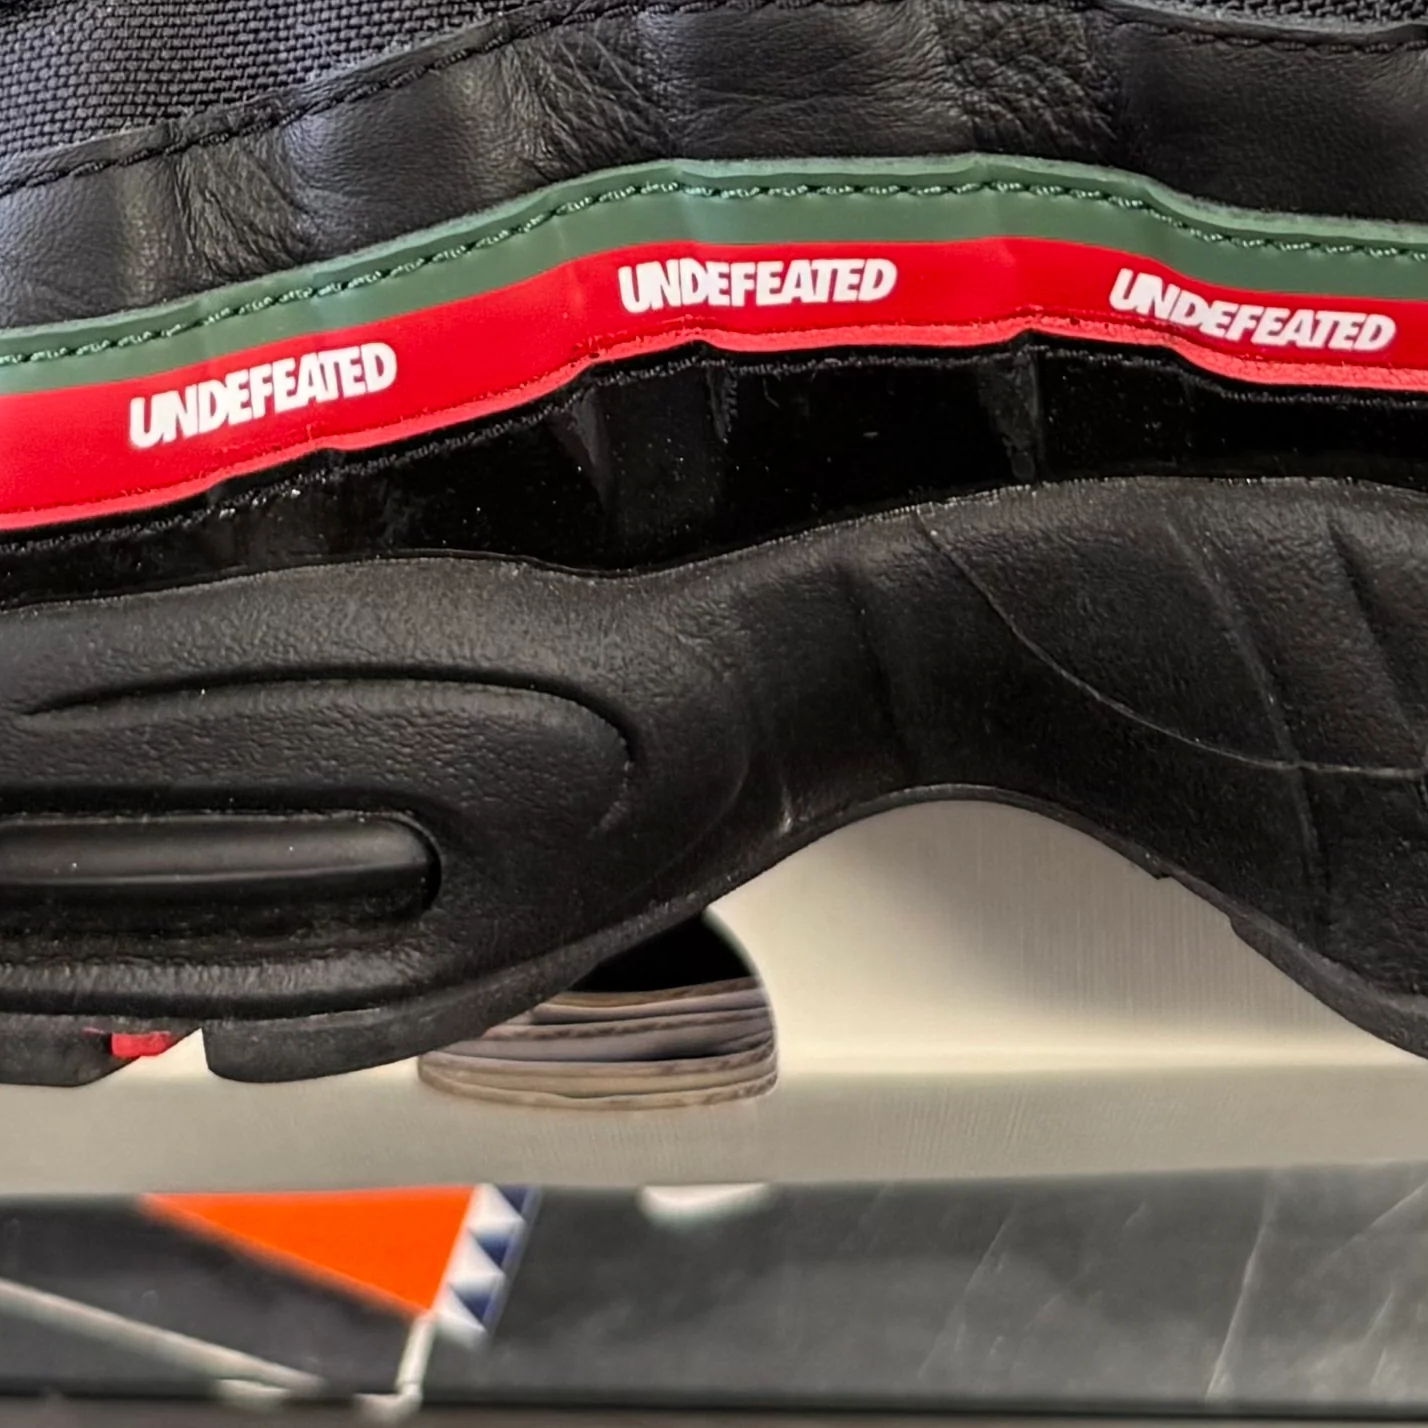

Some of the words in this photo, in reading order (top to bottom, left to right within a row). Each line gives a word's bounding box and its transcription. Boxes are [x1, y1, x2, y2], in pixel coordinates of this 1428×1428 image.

[617, 256, 899, 315] UNDEFEATED
[1108, 267, 1397, 353] UNDEFEATED
[127, 341, 399, 450] UNDEFEATED
